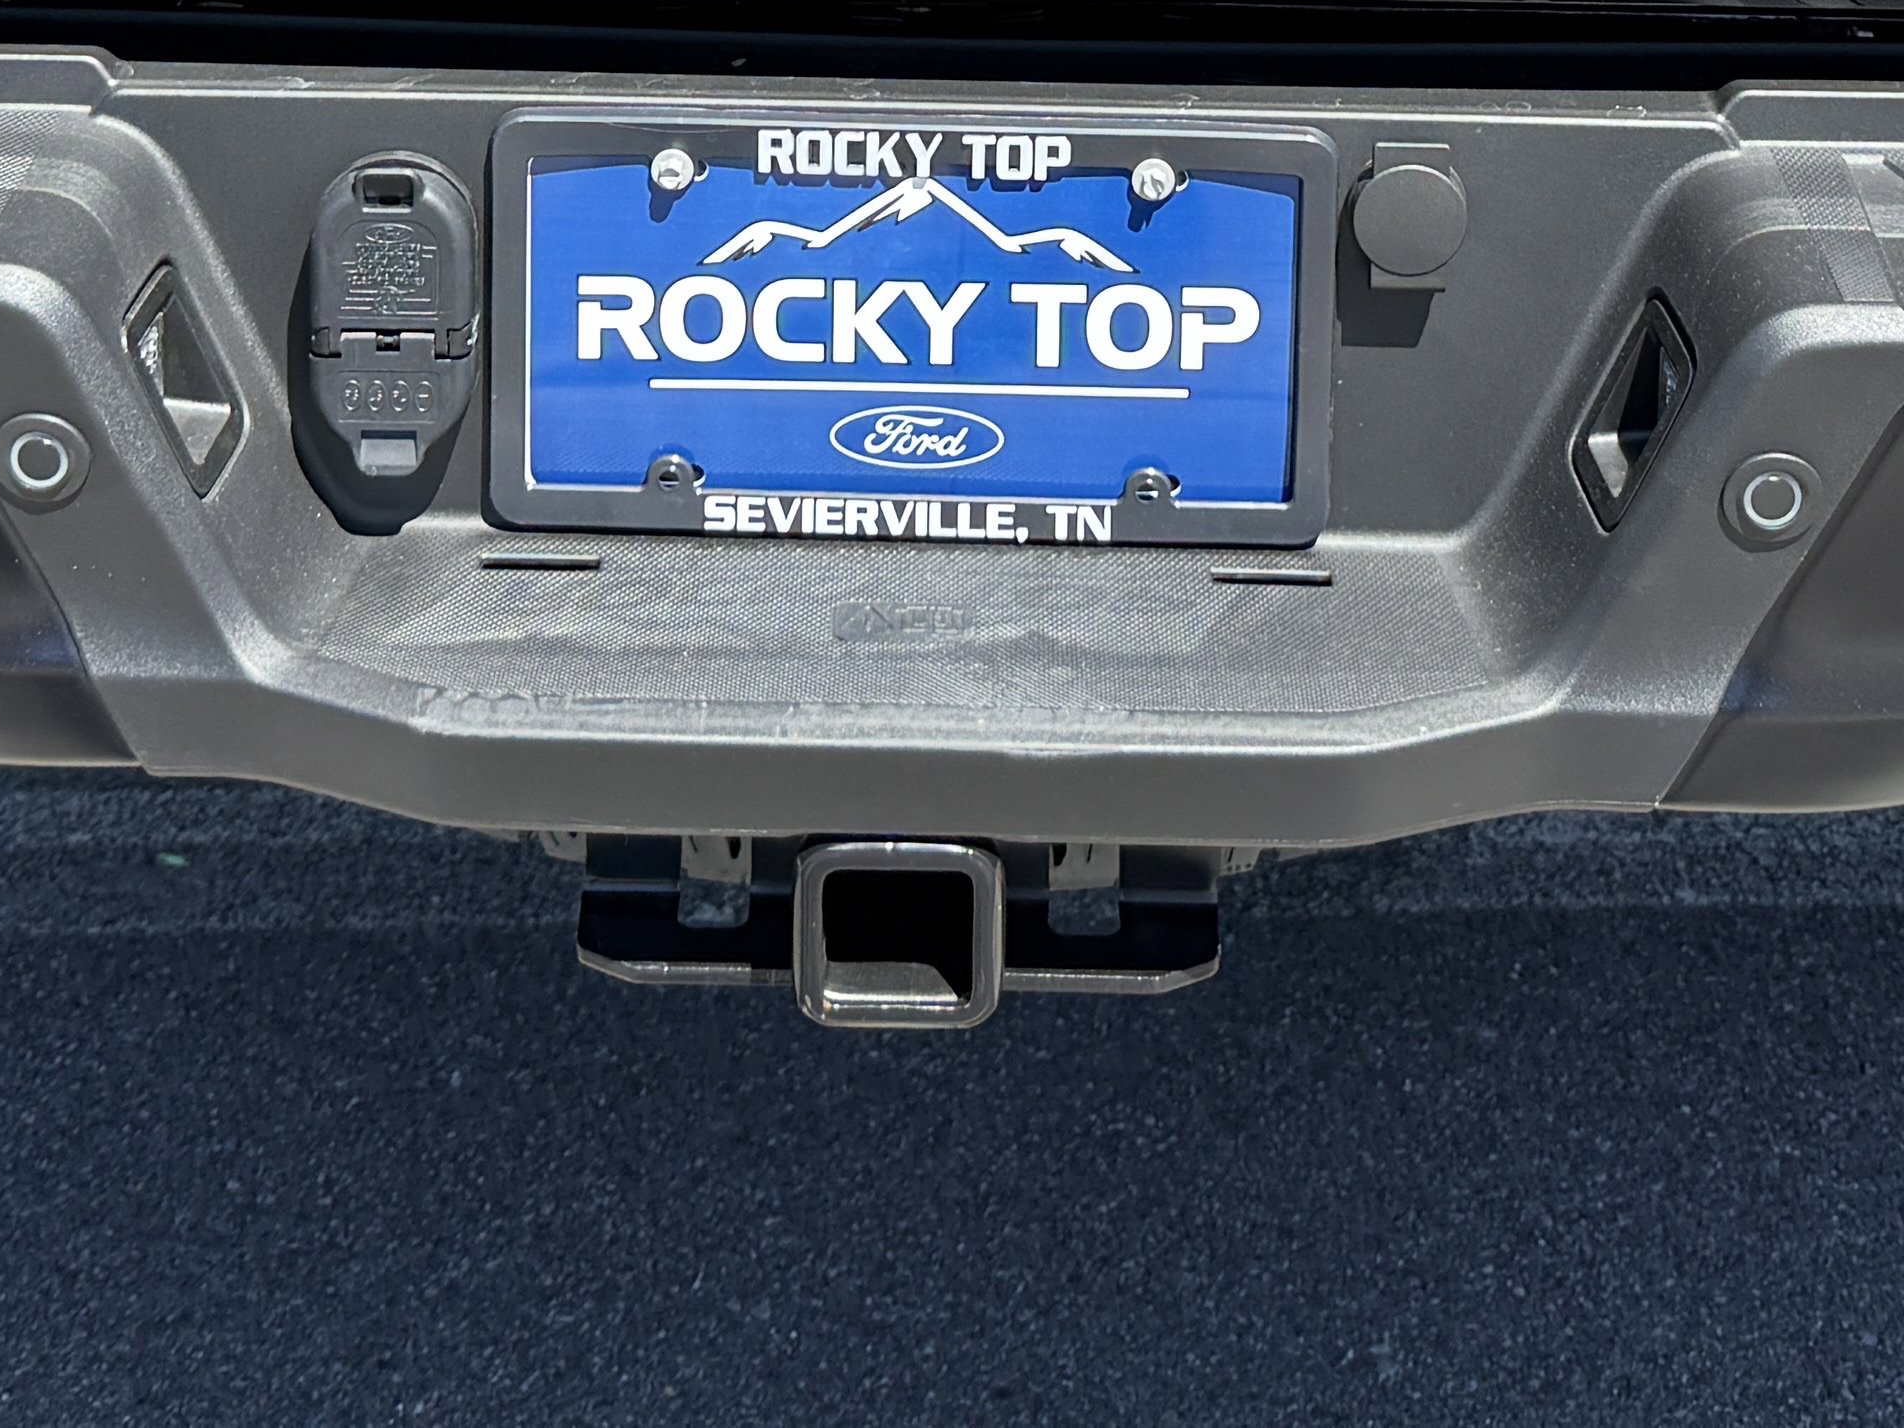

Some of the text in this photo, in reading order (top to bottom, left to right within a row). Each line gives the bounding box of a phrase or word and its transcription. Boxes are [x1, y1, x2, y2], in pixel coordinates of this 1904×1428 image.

[756, 128, 1072, 182] ROCKY TOP
[577, 275, 1262, 370] ROCKY TOP
[863, 413, 969, 457] Ford
[703, 494, 1112, 544] SEVIERVILLE, TN
